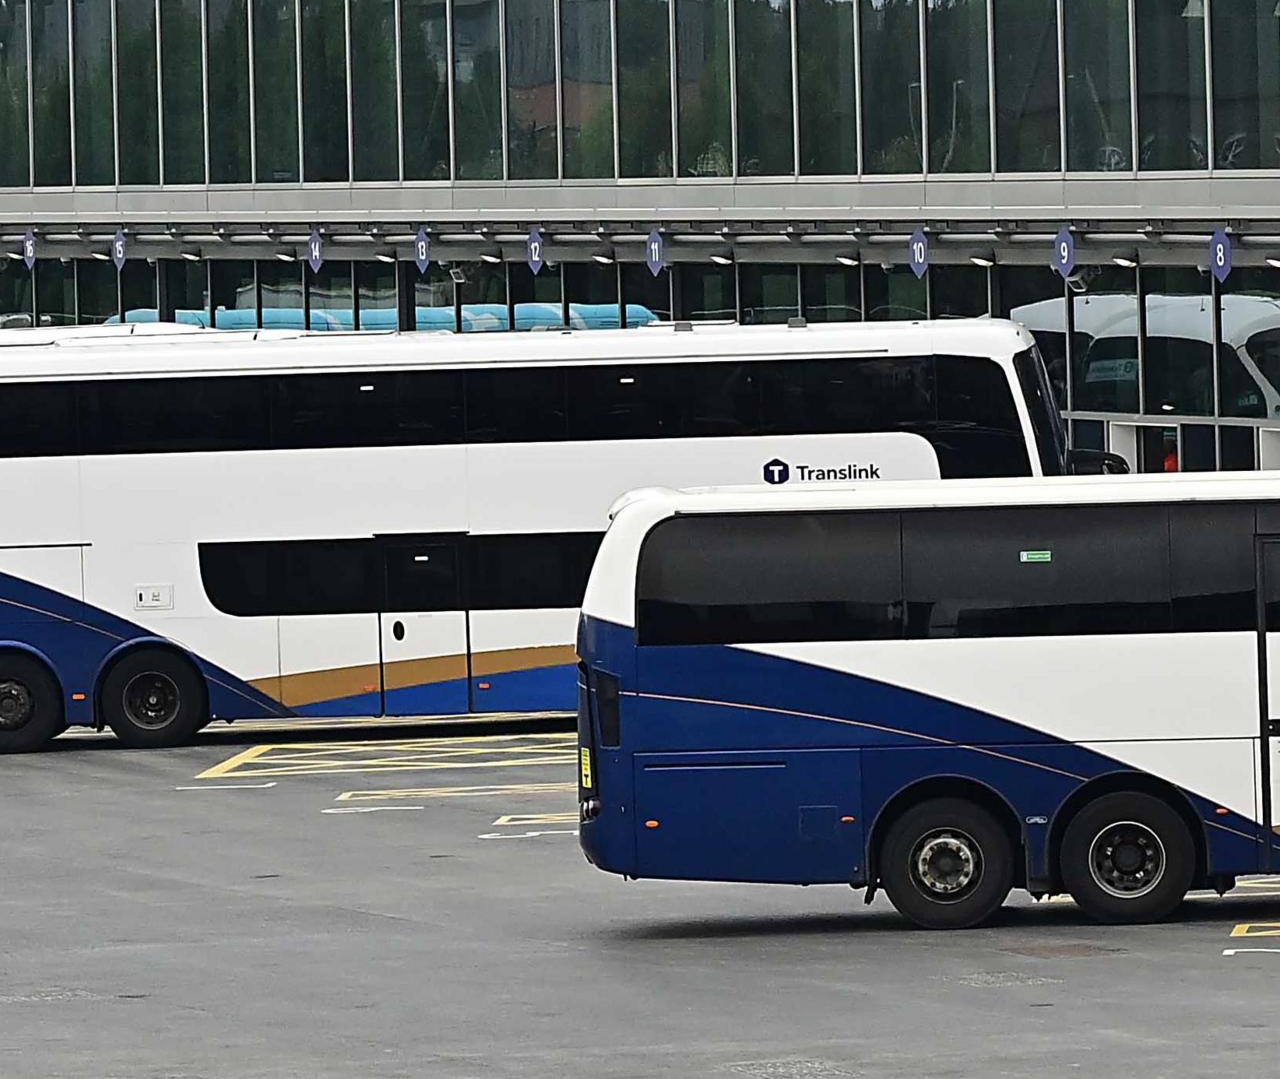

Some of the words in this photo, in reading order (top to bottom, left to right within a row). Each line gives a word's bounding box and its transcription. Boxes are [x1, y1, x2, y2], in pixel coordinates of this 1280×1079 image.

[311, 241, 320, 260] 14
[417, 241, 426, 260] 13
[530, 242, 540, 261] 12
[650, 242, 659, 262] 11
[912, 242, 925, 264] 10
[1060, 242, 1069, 264] 9
[1216, 243, 1225, 266] 8
[796, 464, 881, 481] Translink
